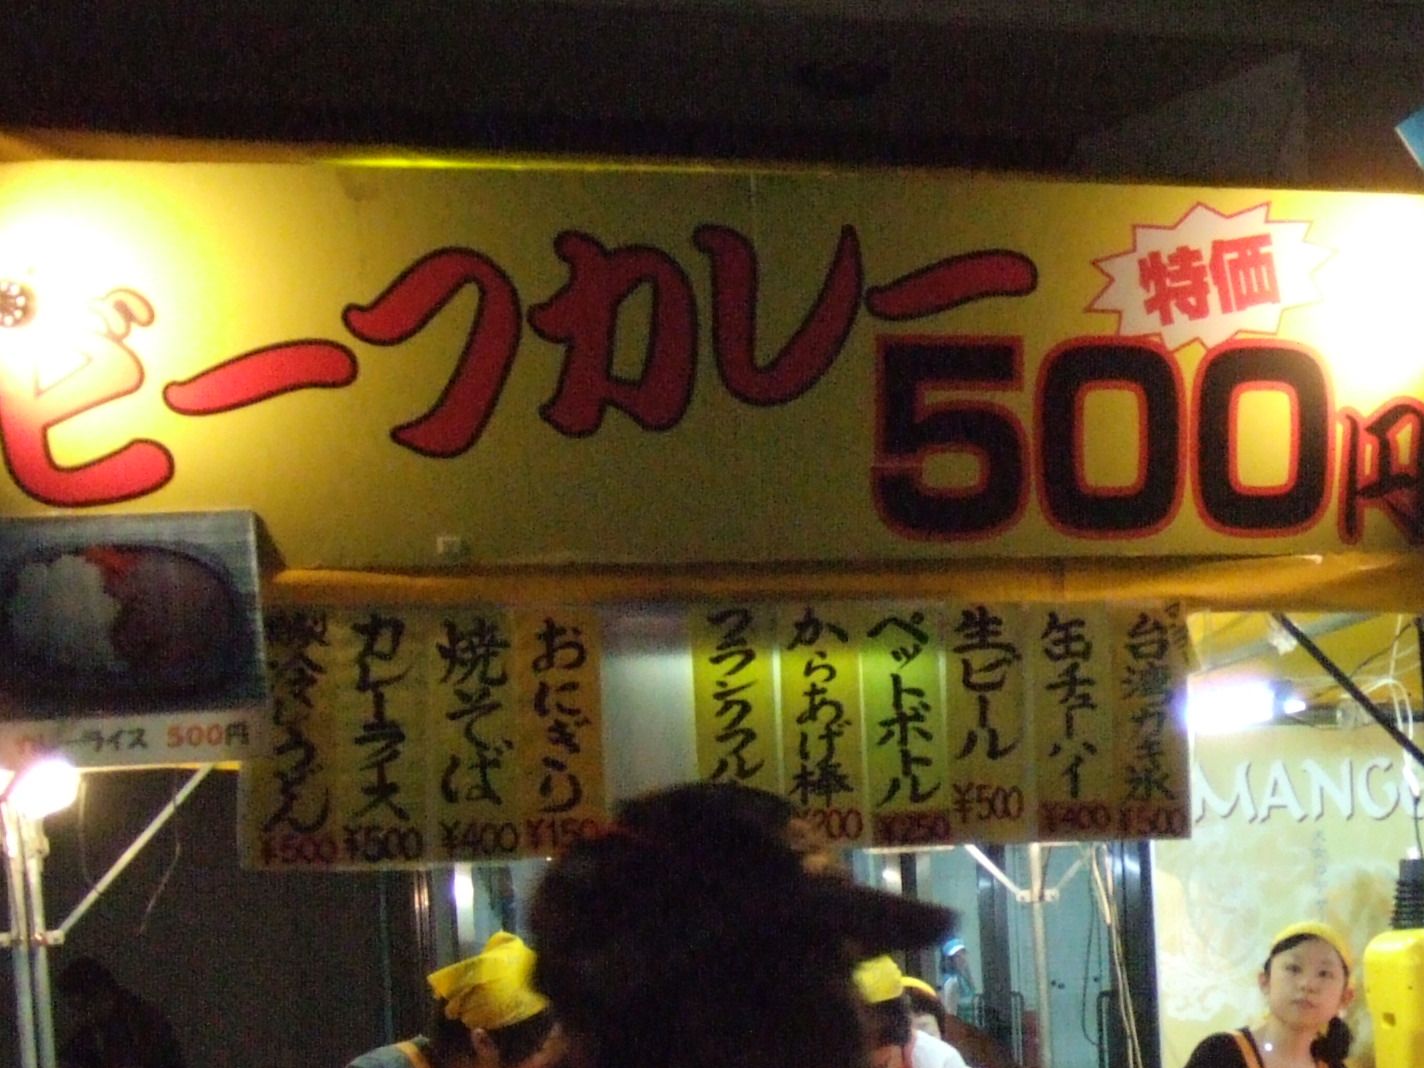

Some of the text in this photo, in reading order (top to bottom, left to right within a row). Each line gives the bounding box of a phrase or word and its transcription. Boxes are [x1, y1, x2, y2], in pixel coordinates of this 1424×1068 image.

[1137, 234, 1281, 326] 特価
[168, 720, 249, 748] 500円
[436, 618, 514, 806] 焼そば
[532, 616, 592, 813] おにぎり
[786, 606, 854, 807] からあげ棒
[867, 611, 942, 808] ペットボトル
[954, 605, 1023, 760] 生ビール
[1041, 612, 1098, 798] 缶チューハイ
[343, 825, 423, 862] ¥500
[439, 818, 519, 854] ¥400
[952, 782, 1024, 822] ¥500
